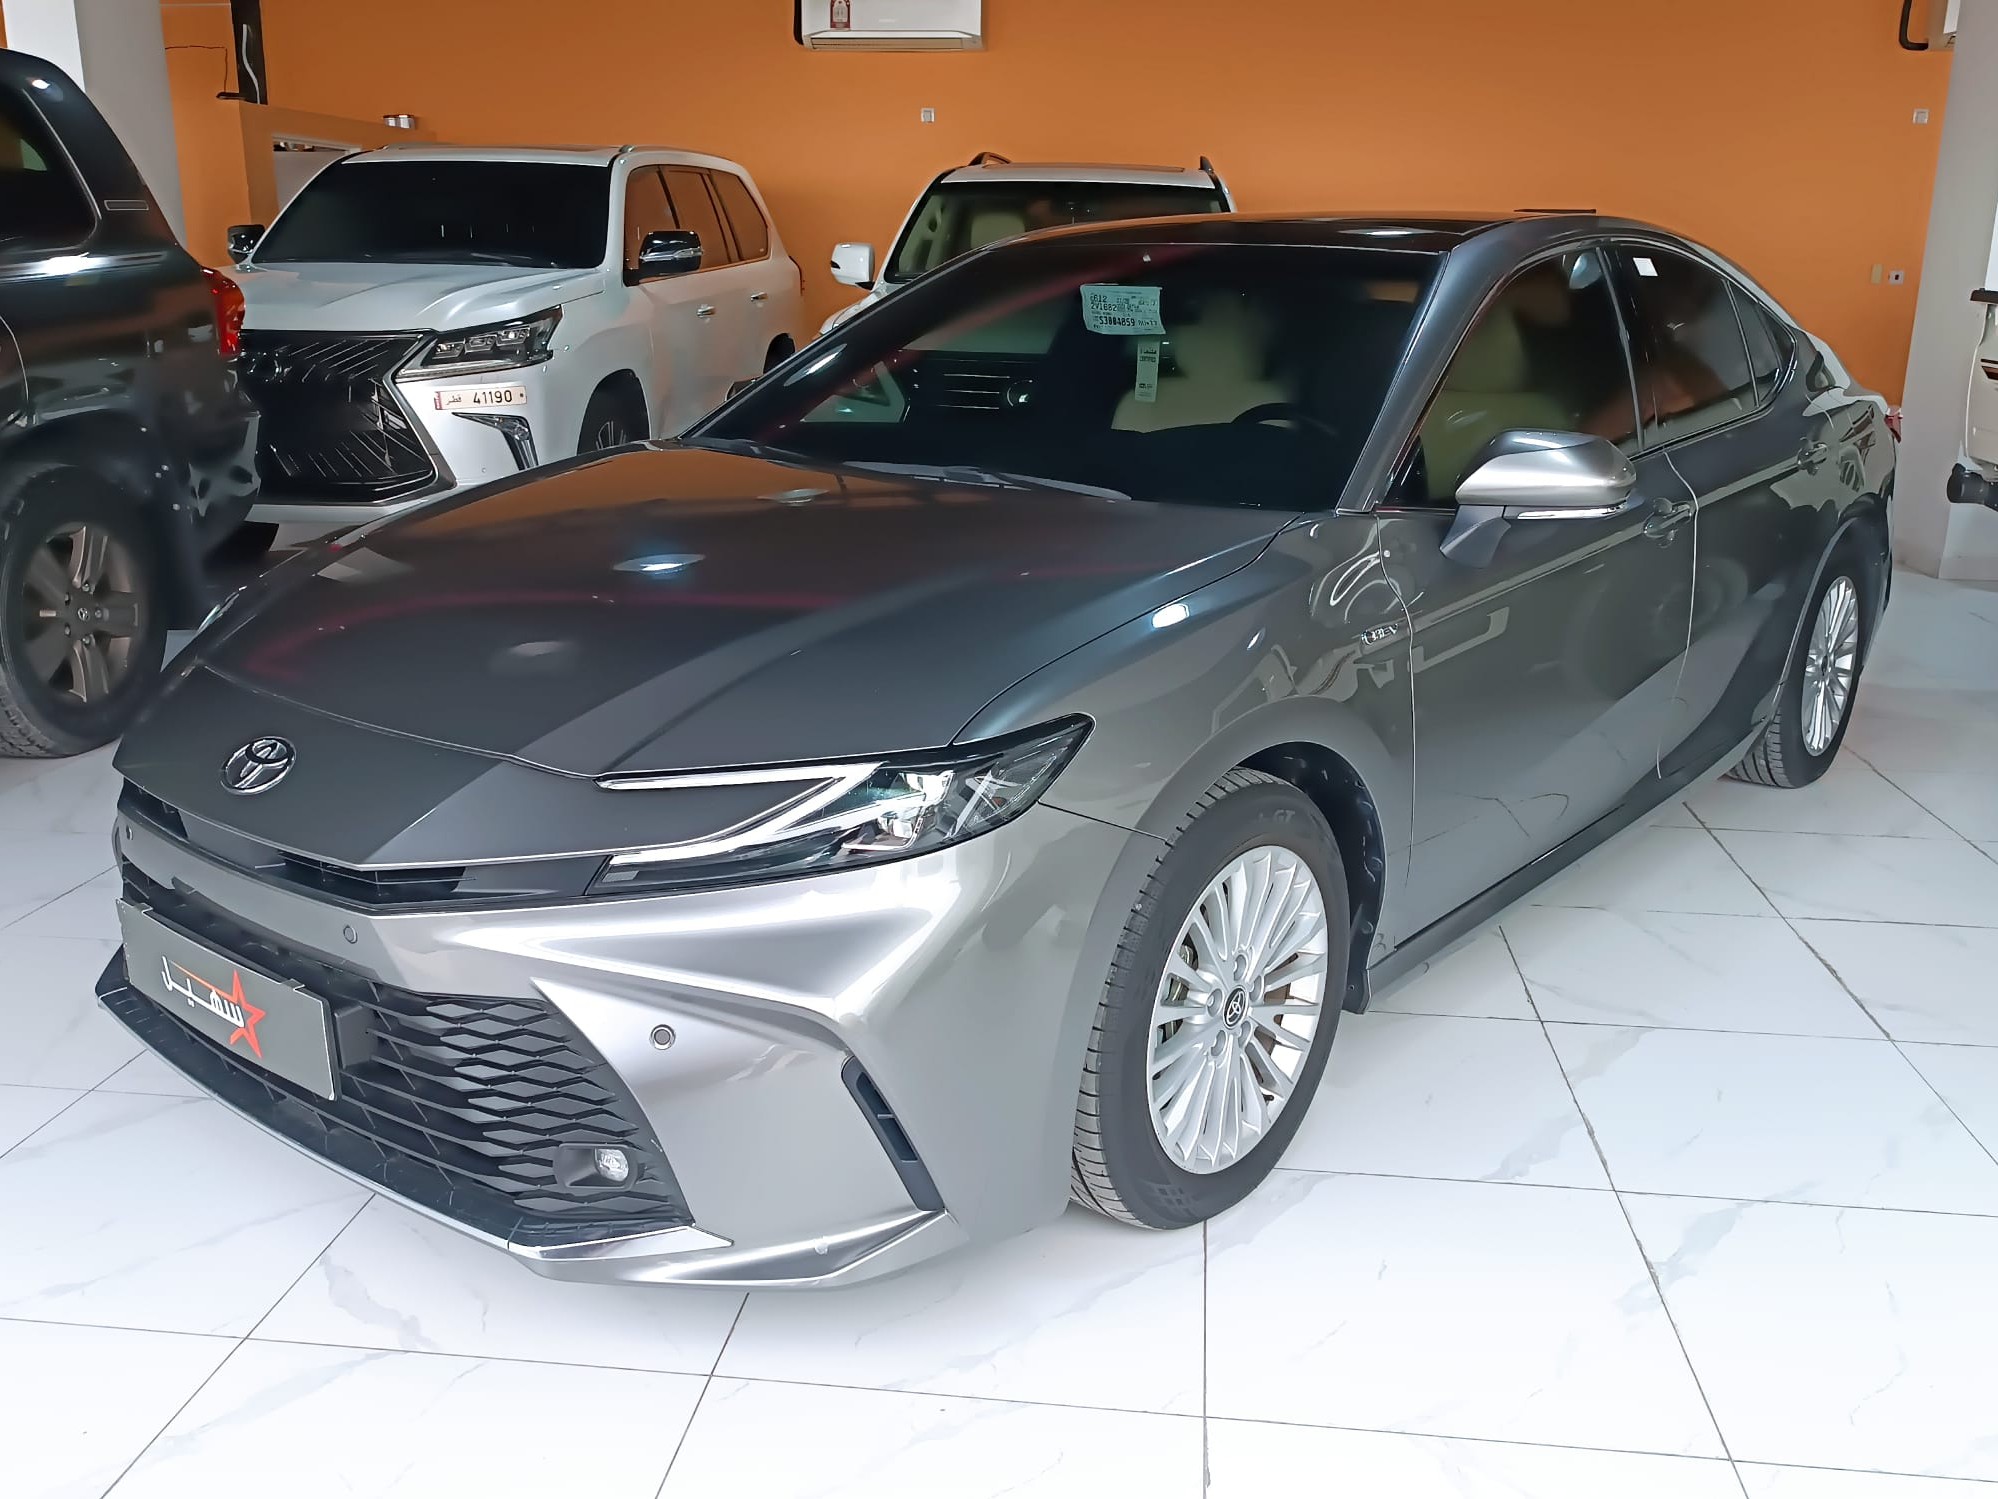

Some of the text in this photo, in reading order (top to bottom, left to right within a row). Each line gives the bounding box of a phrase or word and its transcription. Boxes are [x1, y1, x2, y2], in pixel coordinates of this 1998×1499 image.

[446, 393, 462, 405] قطر
[473, 389, 513, 405] 41190
[161, 955, 245, 1029] سهيل
